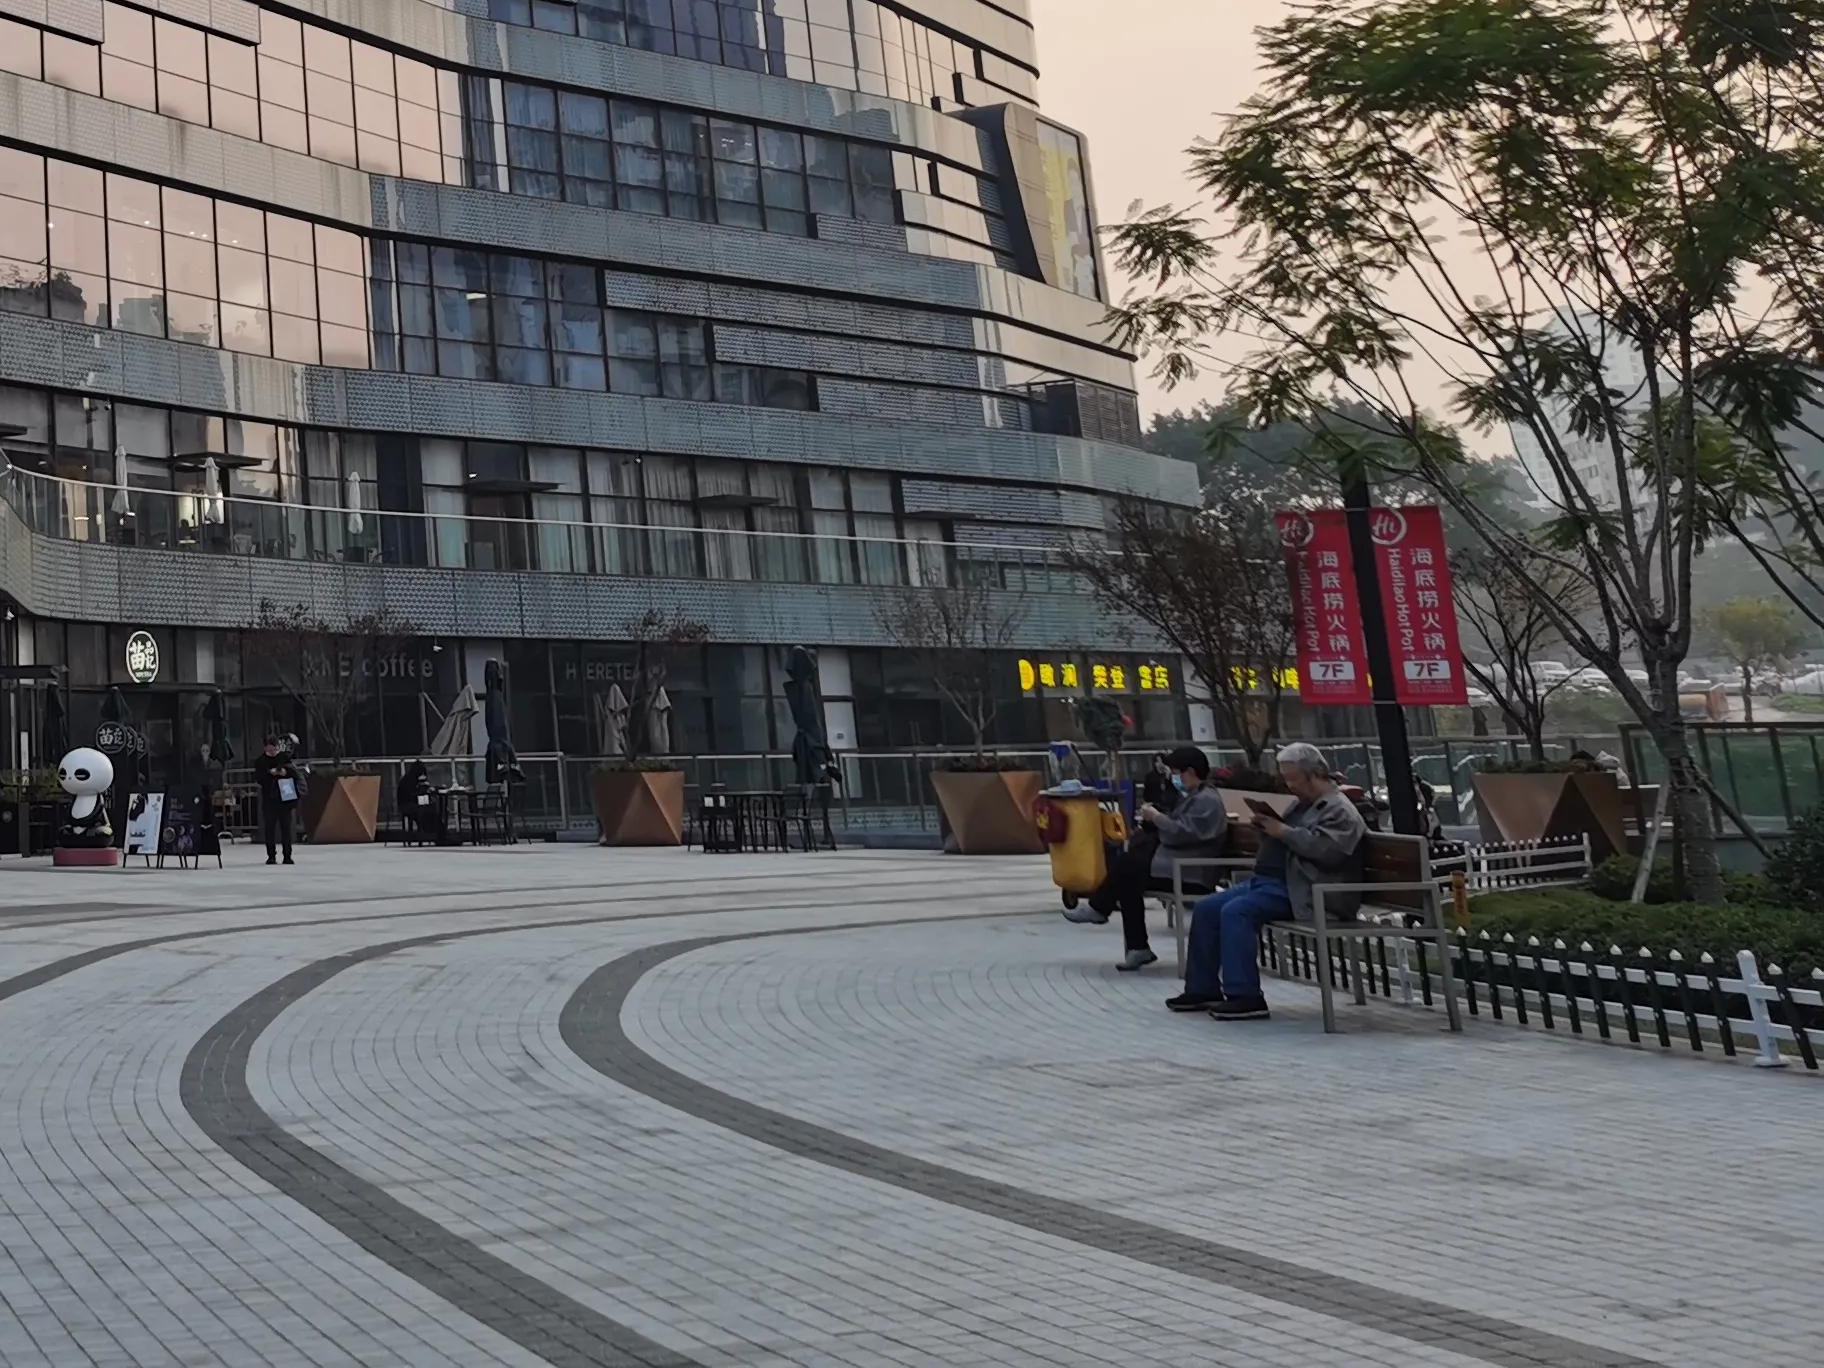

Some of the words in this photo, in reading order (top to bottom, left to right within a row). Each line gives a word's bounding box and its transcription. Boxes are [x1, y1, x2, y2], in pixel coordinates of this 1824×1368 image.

[1317, 550, 1351, 652] 海底捞火锅
[1410, 547, 1446, 652] 海底捞火锅
[1319, 663, 1345, 678] 7F
[1412, 662, 1440, 678] 7F
